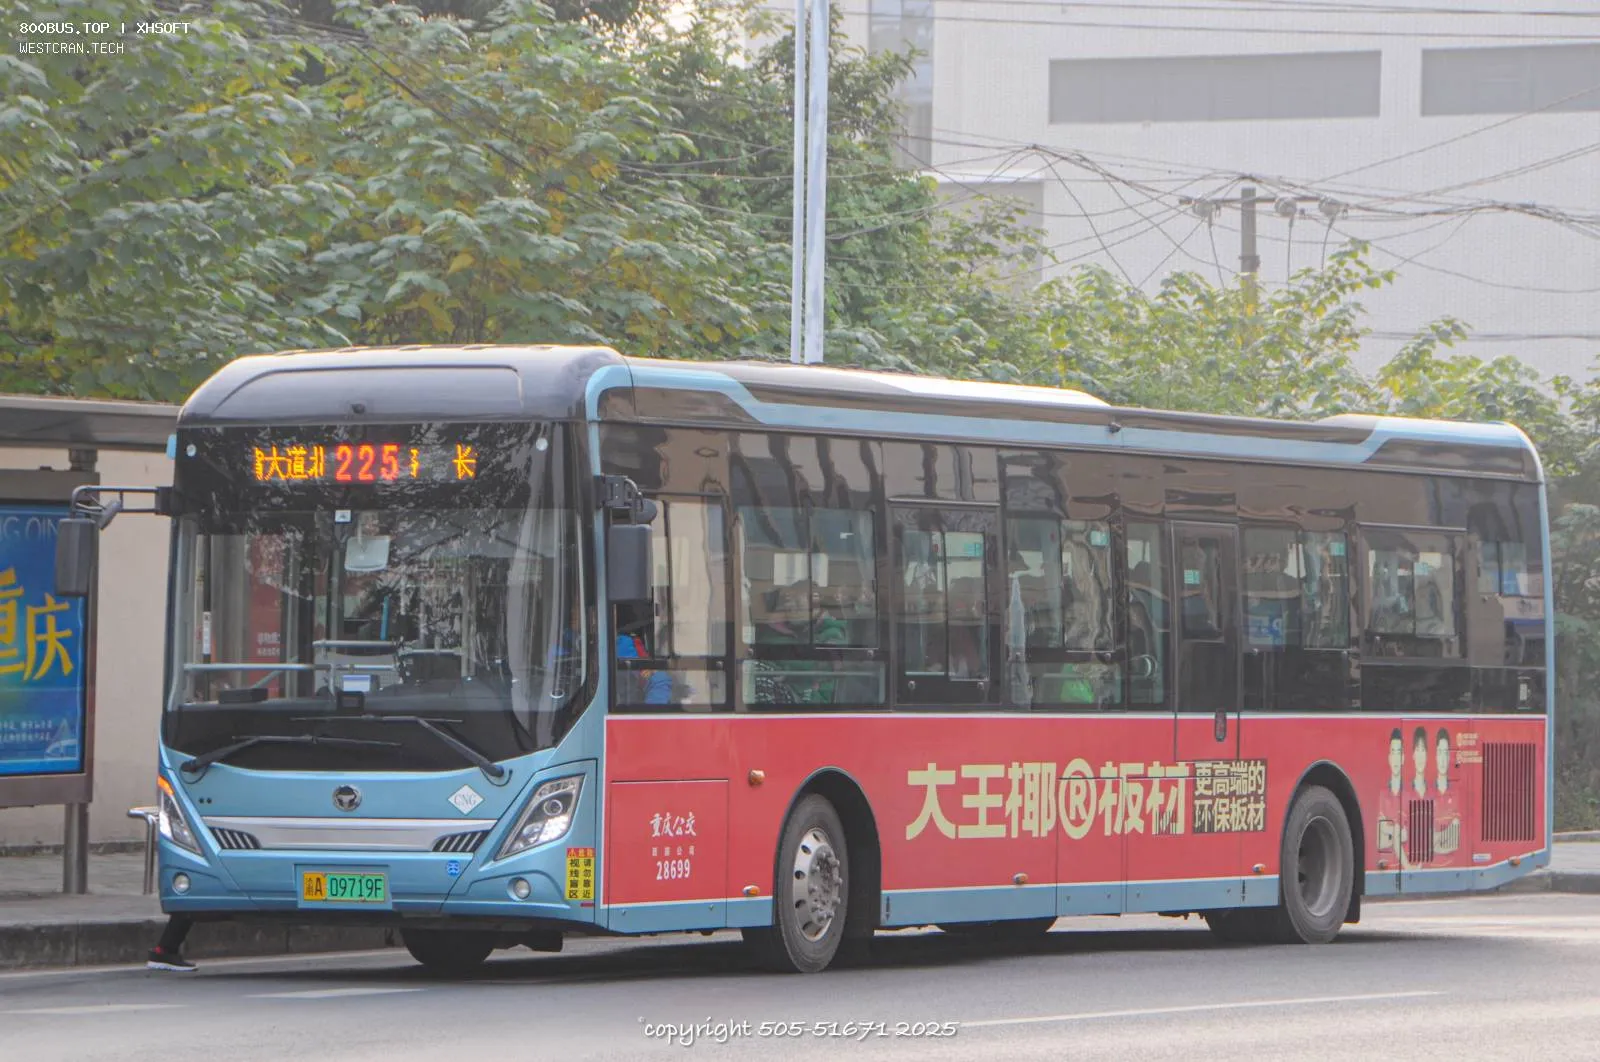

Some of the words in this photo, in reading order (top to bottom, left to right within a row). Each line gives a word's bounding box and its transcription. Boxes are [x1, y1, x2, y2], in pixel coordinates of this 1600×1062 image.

[335, 444, 399, 482] 225
[1194, 760, 1266, 796] 更高端的
[649, 811, 697, 838] 重庆公交
[1194, 795, 1266, 833] 环保板材
[656, 858, 691, 881] 28699
[330, 877, 383, 898] 09719F
